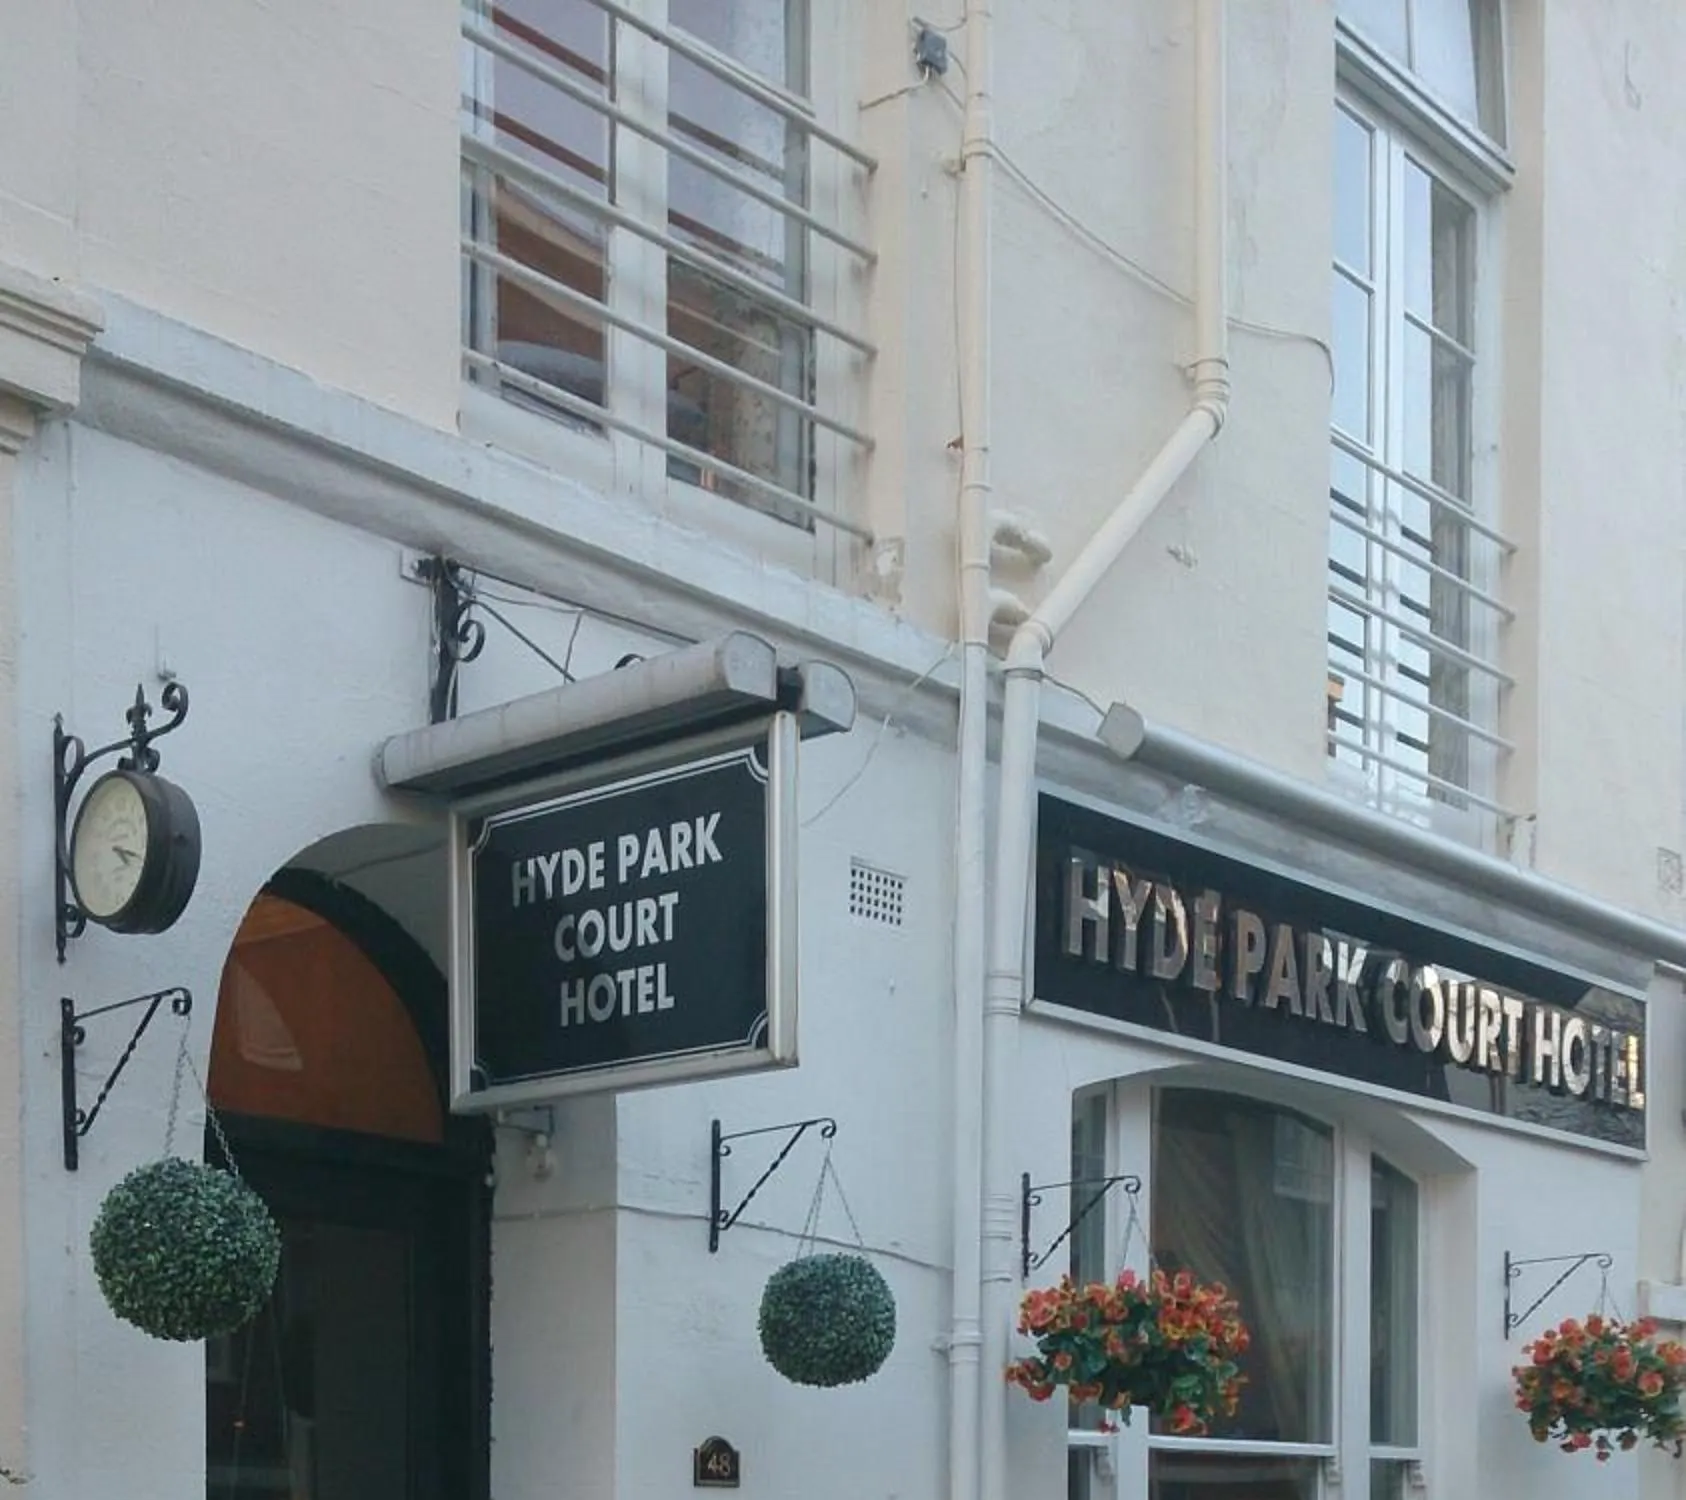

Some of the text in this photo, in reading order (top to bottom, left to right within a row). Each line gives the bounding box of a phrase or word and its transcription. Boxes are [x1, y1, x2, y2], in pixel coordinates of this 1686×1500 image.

[511, 811, 723, 908] HYDE PARK
[553, 891, 680, 963] COURT
[559, 962, 675, 1028] HOTEL
[1066, 854, 1645, 1110] HYDE PARK COURT HOTEL
[707, 1452, 731, 1477] 48
